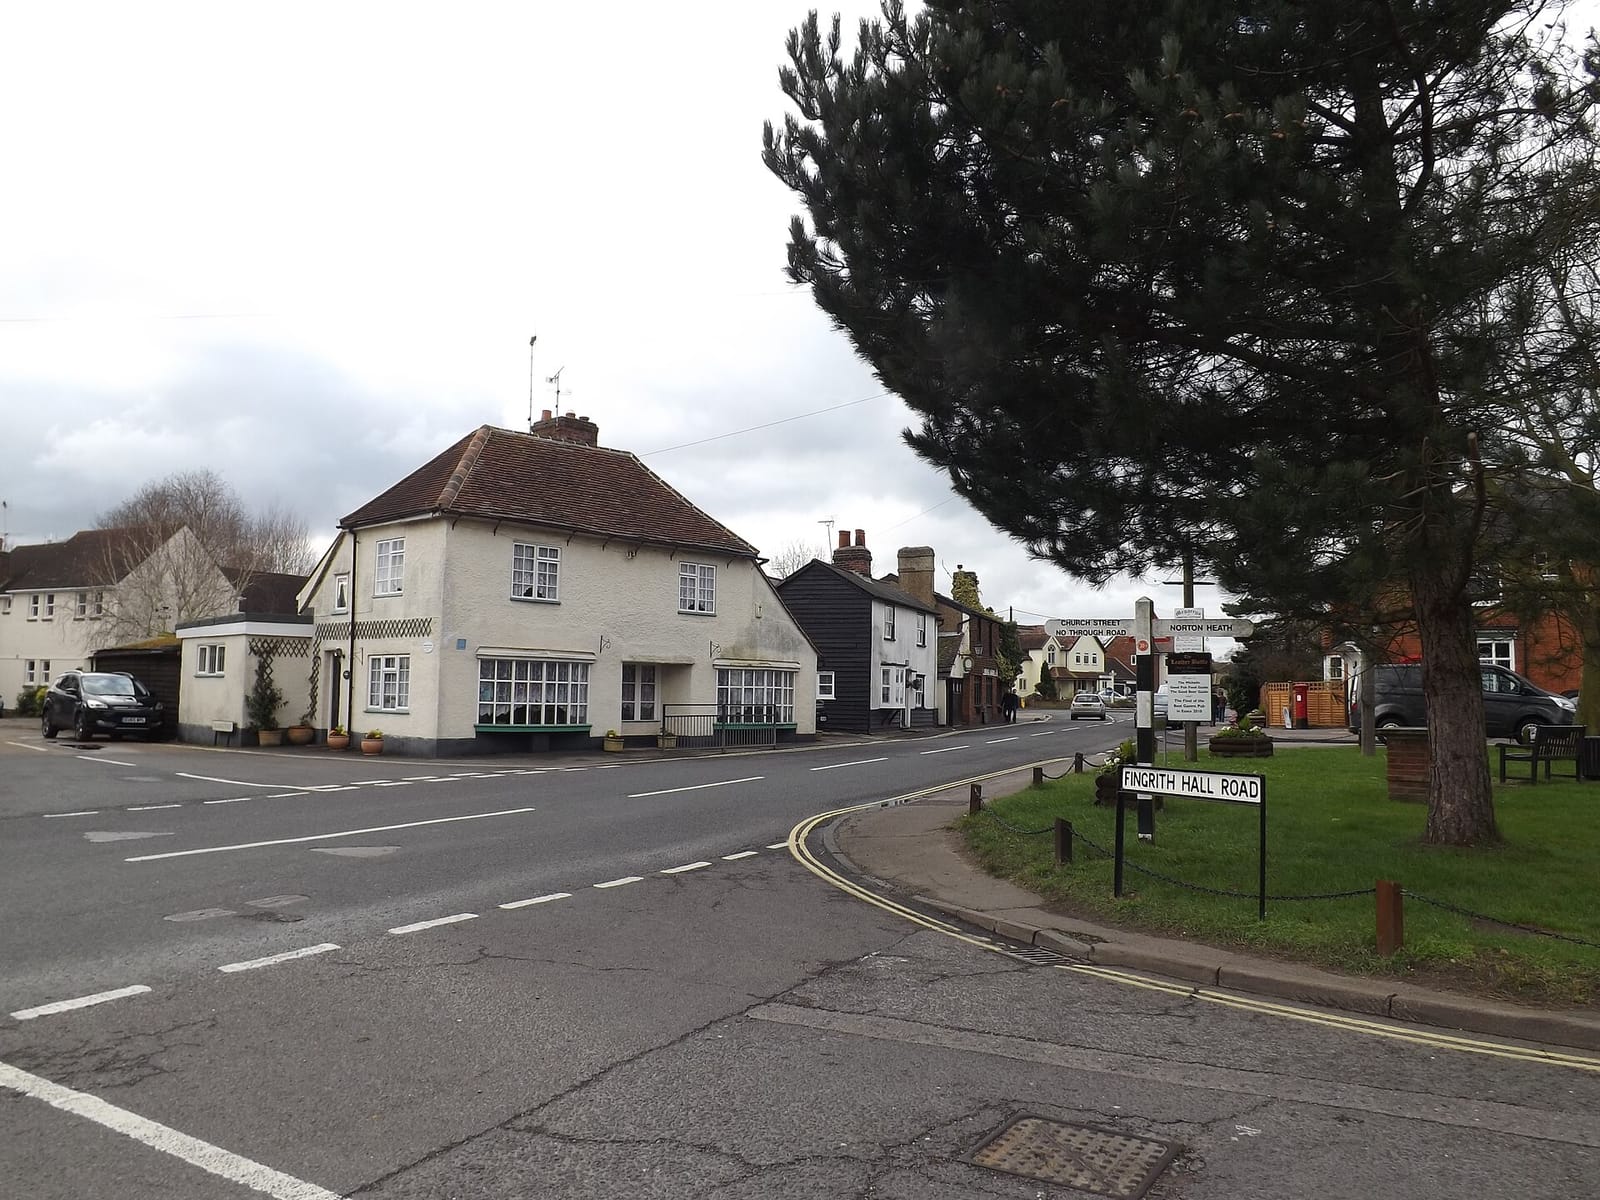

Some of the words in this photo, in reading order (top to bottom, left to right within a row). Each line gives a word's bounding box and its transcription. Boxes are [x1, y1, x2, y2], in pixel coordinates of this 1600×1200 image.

[1170, 624, 1203, 632] NORTON
[1206, 624, 1233, 632] HEATH
[1124, 771, 1176, 790] FINGRITH
[1181, 775, 1214, 794] HALL
[1221, 778, 1258, 798] ROAD
